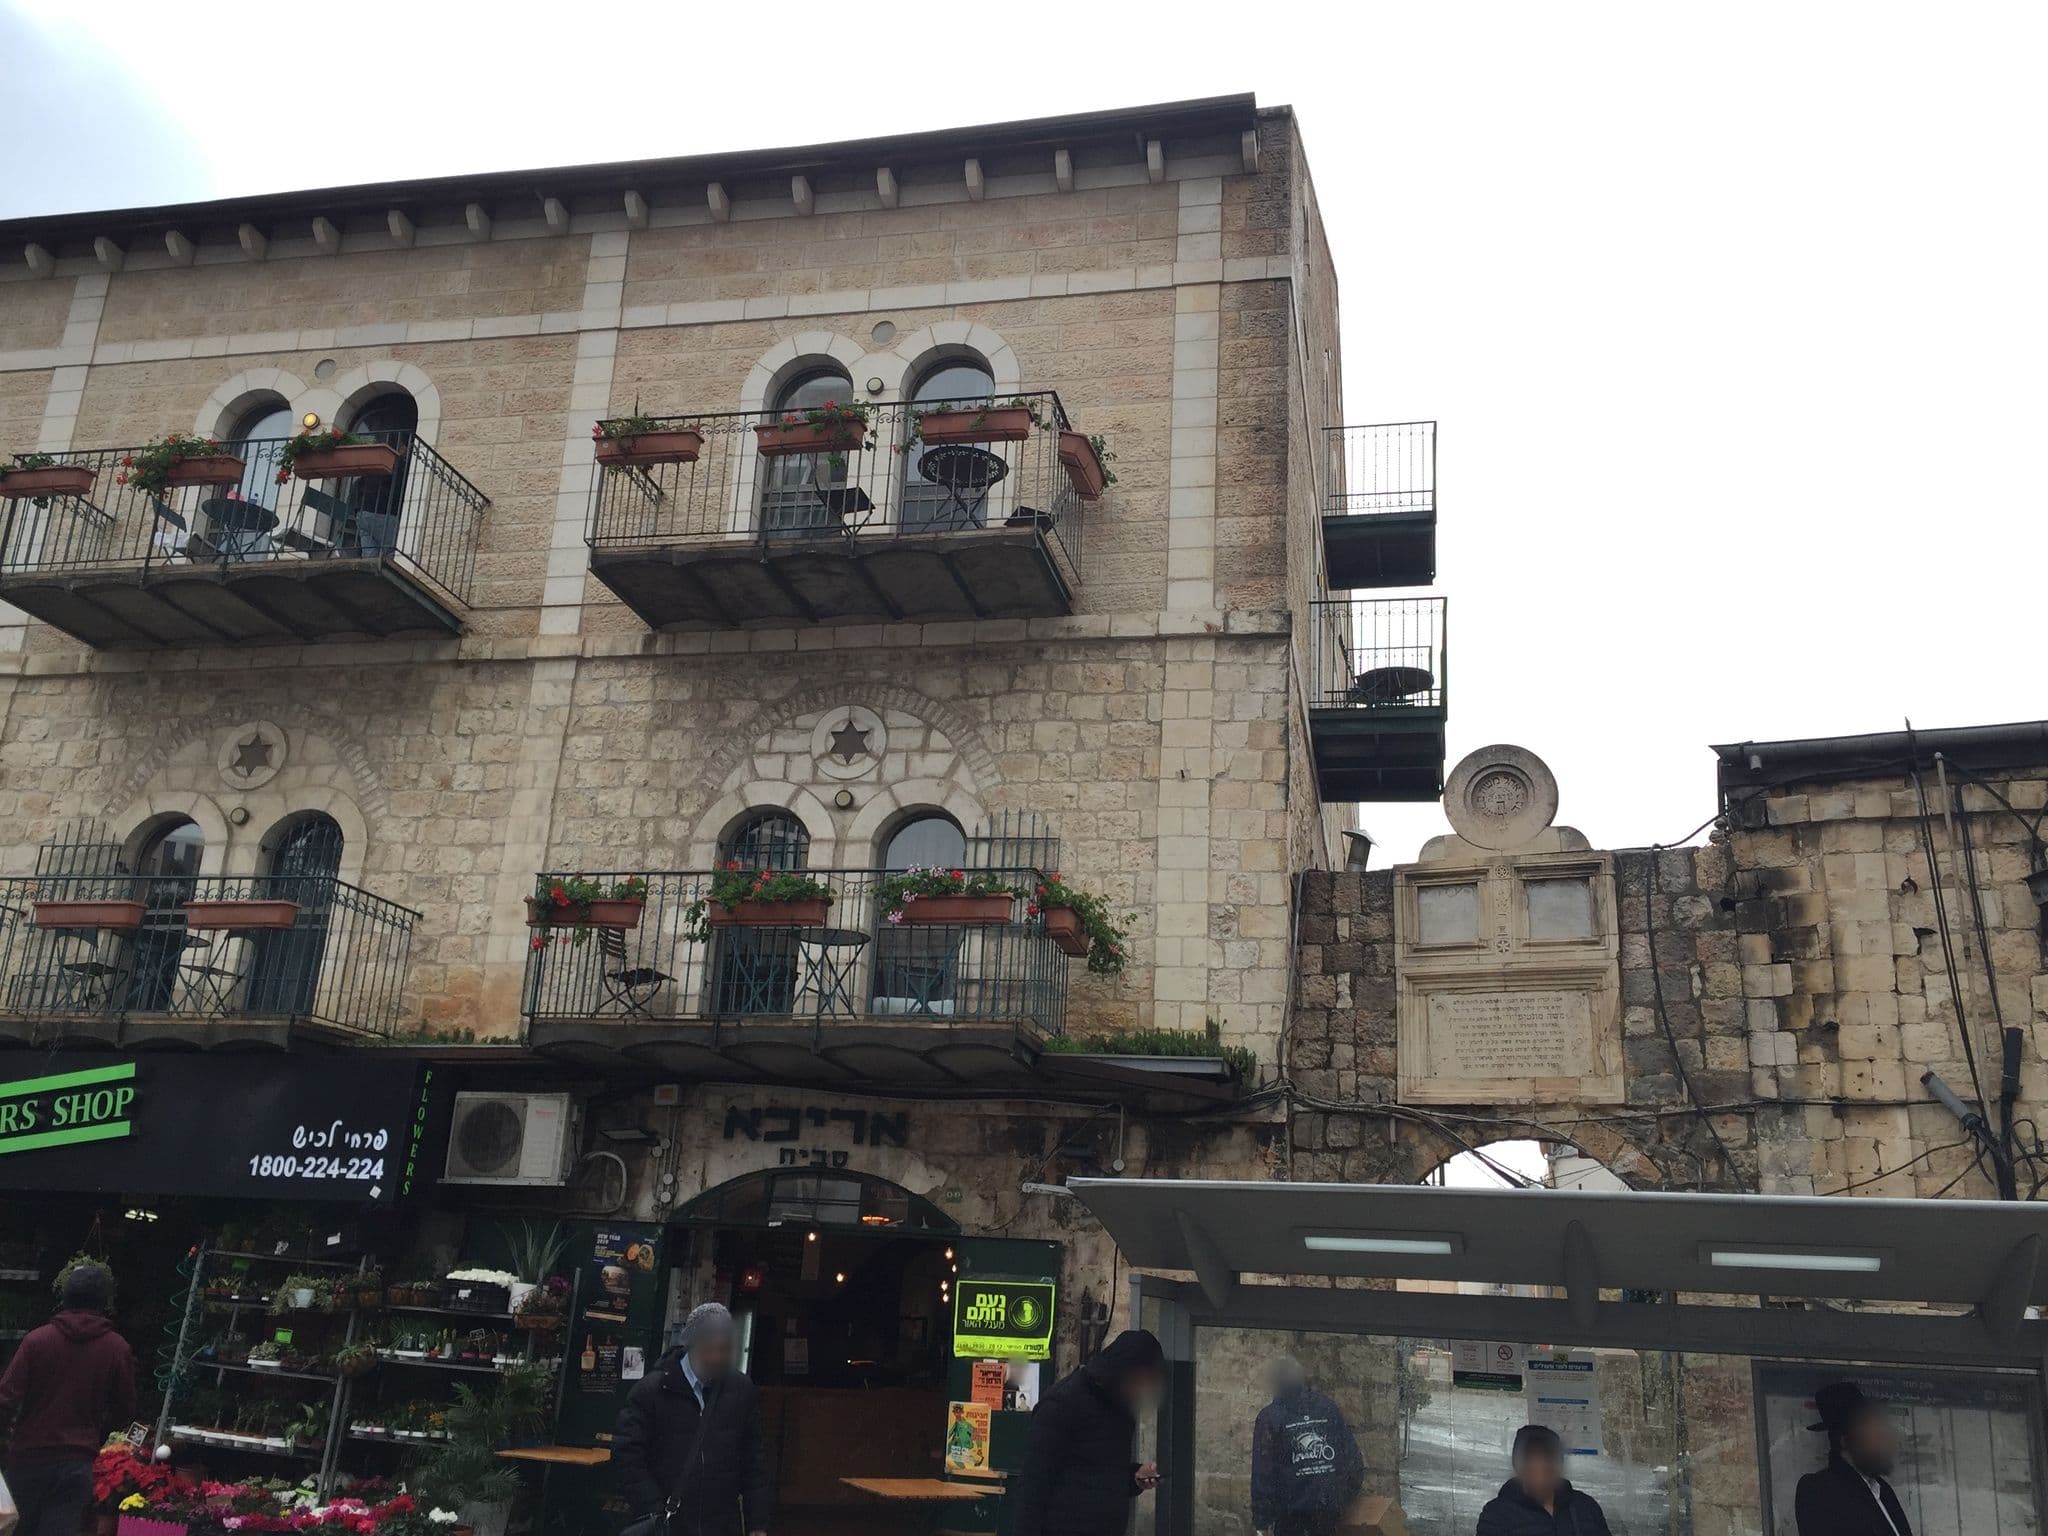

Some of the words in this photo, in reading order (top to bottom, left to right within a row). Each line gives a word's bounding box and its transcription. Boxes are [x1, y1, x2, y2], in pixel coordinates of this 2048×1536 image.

[52, 1087, 134, 1126] SHOP
[292, 1120, 343, 1149] לכיש
[402, 1070, 433, 1196] FLOWERS
[723, 1105, 908, 1146] אריכא
[344, 1128, 388, 1151] פרחי
[249, 1154, 384, 1180] 1800-224-224
[779, 1147, 848, 1167] סביח
[966, 1306, 1006, 1321] רותם
[976, 1293, 1007, 1308] נעם
